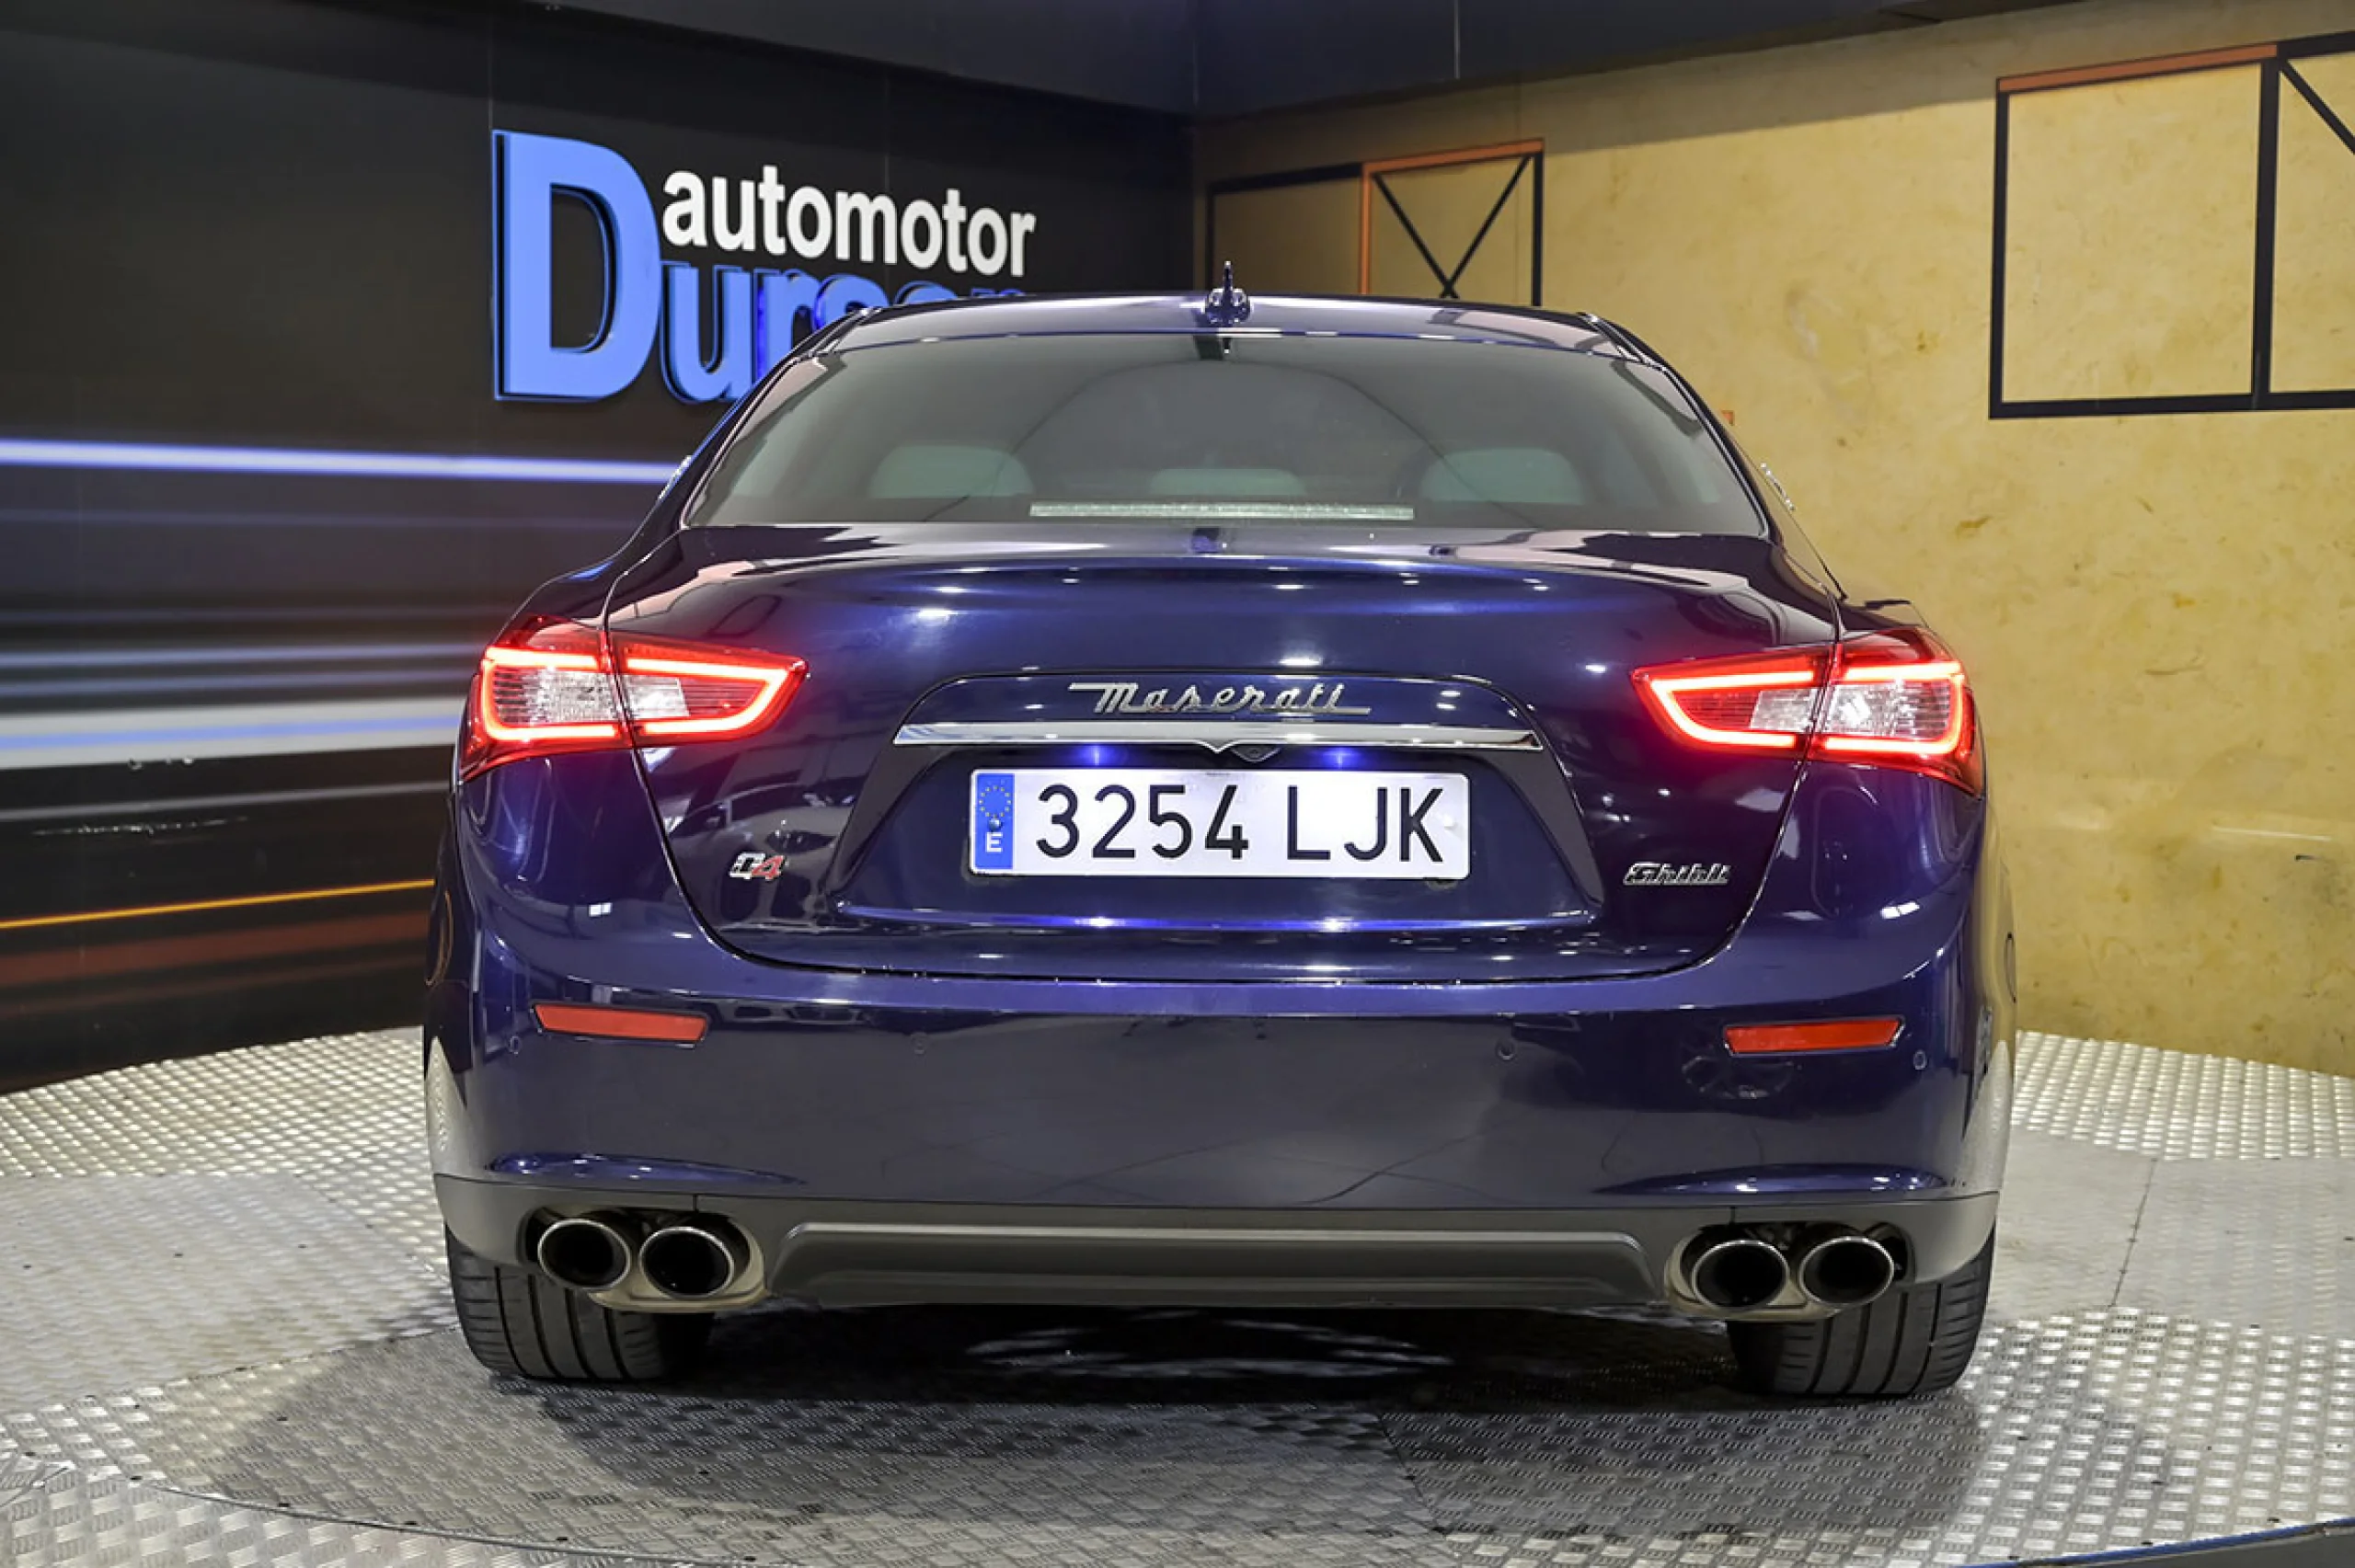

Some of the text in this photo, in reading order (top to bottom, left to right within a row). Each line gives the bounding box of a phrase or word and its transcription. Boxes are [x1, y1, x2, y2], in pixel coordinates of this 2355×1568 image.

[662, 164, 1036, 277] automotor
[1068, 682, 1372, 714] Maserati
[1035, 784, 1443, 863] 3254 LJK
[985, 831, 1004, 853] E
[1623, 862, 1731, 886] Ghibli
